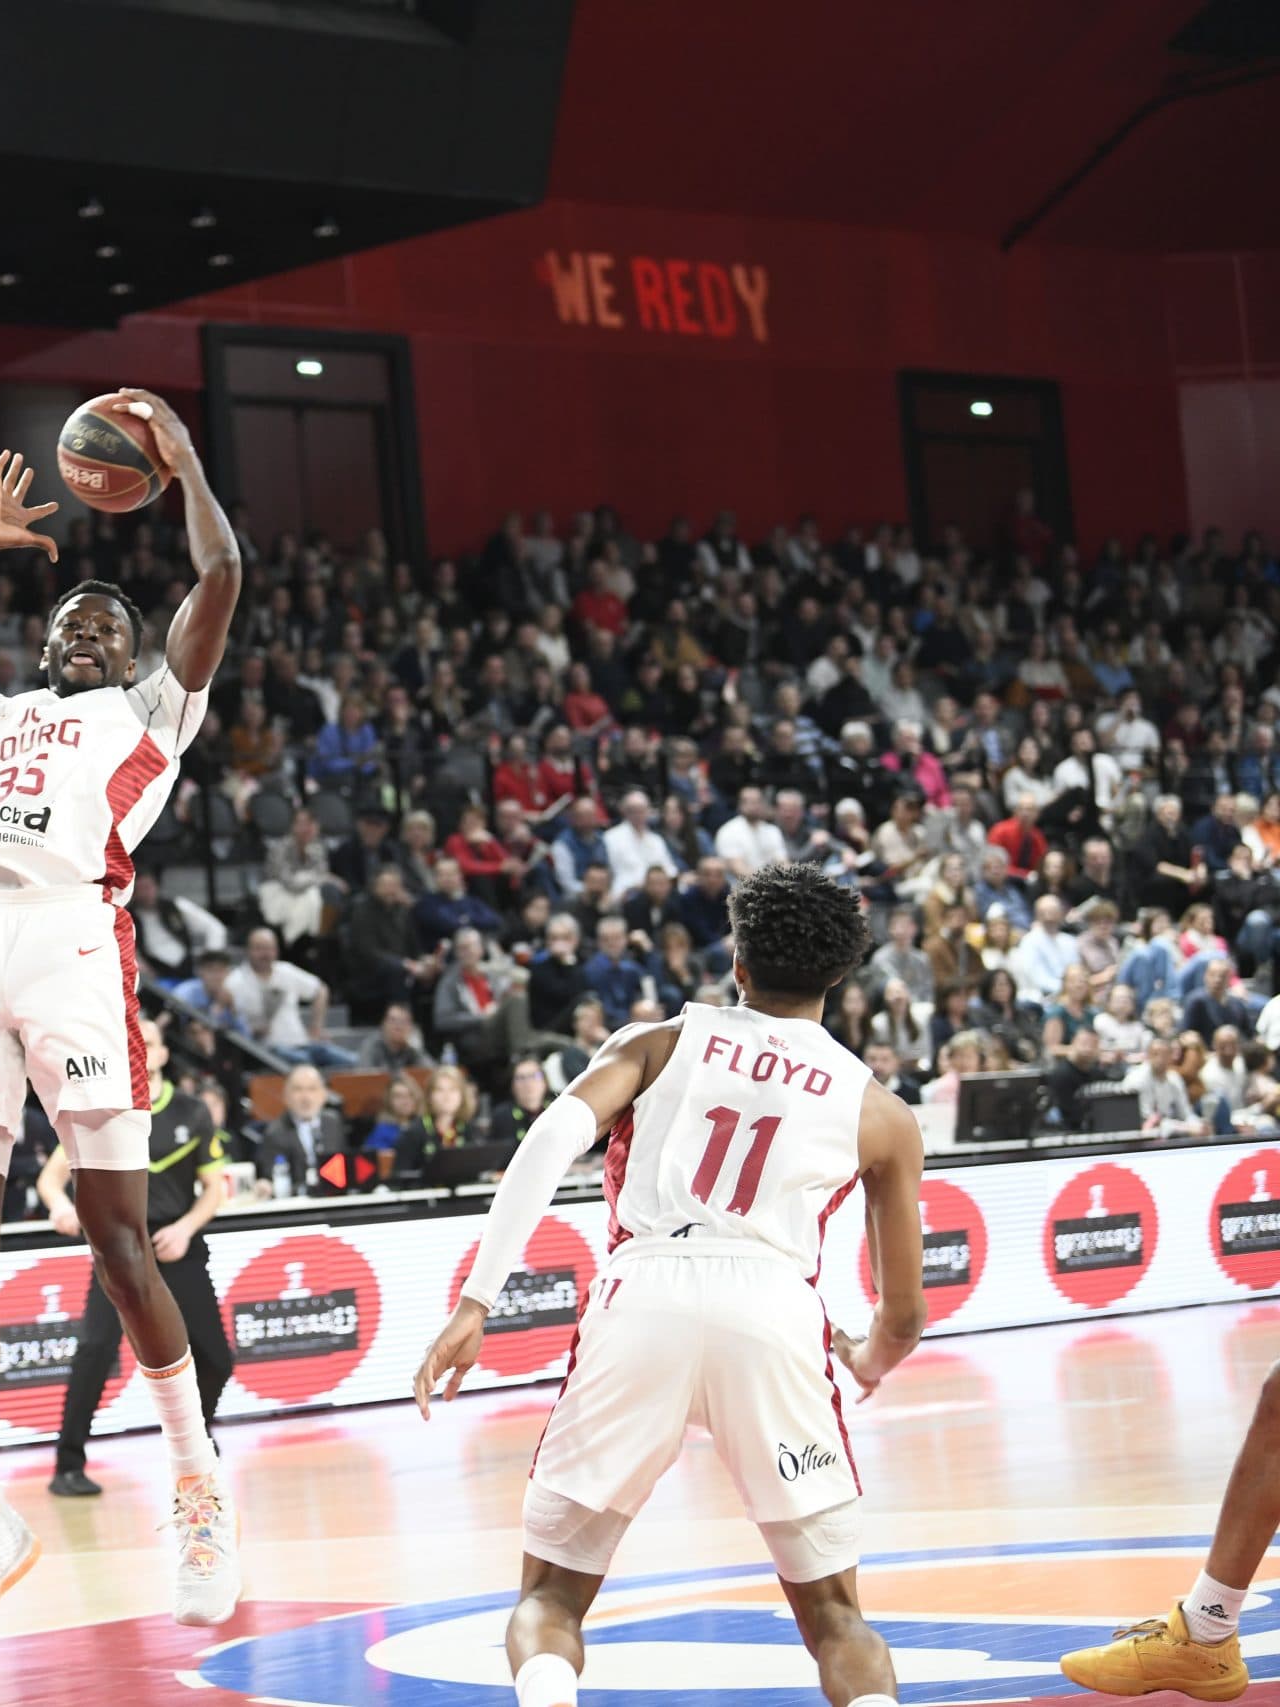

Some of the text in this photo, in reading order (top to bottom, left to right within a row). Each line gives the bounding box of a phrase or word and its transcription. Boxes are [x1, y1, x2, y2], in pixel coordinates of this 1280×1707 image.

[544, 250, 770, 342] WE REDY
[66, 1055, 107, 1080] AIN
[702, 1034, 833, 1097] FLOYD
[690, 1105, 784, 1218] 11
[598, 1278, 623, 1310] 11
